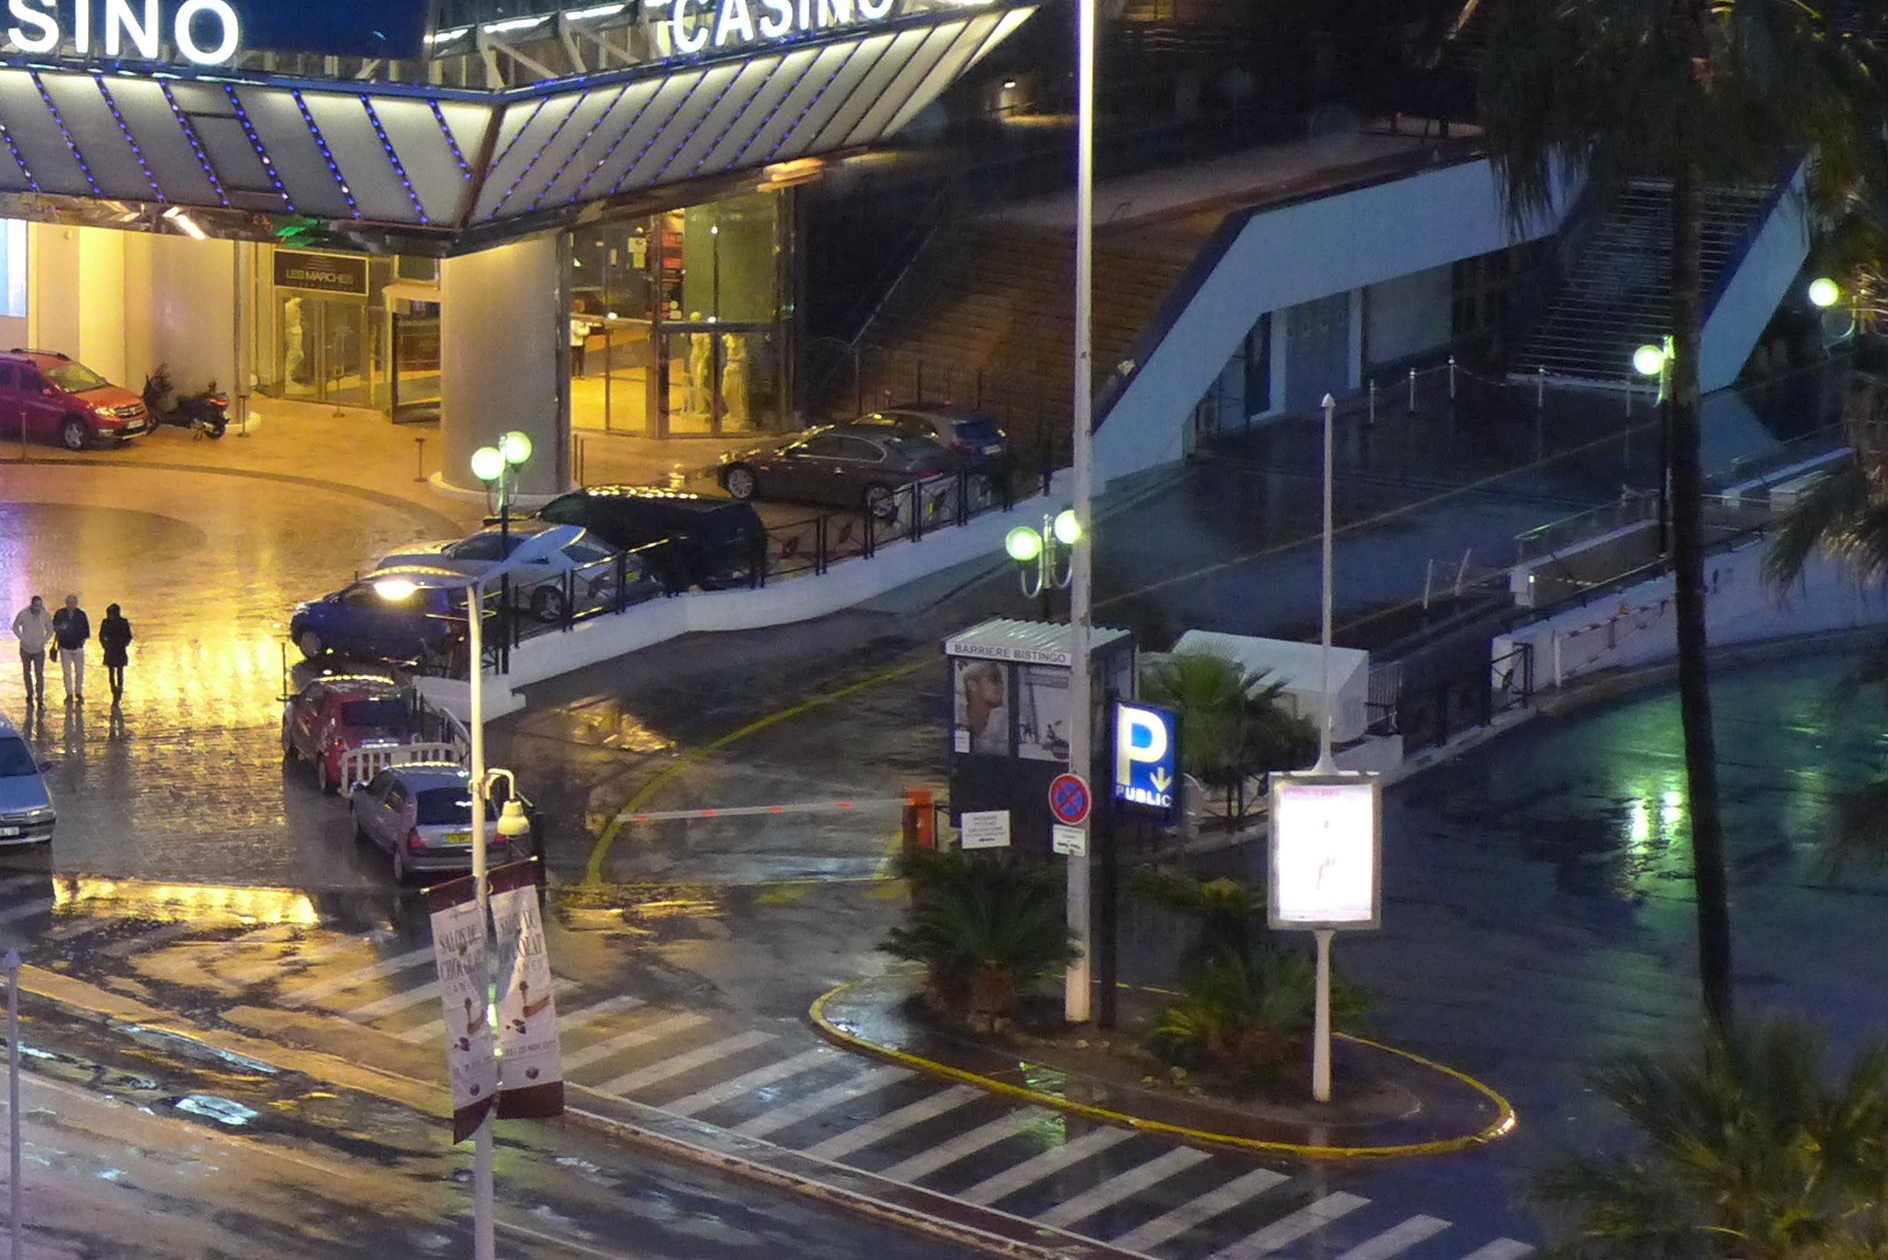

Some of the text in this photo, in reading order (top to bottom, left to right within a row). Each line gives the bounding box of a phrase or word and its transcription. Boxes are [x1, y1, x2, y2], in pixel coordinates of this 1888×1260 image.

[954, 643, 1067, 663] BARRIERE BISTINGO
[1117, 703, 1168, 786] P
[1115, 784, 1172, 808] PUBLIC
